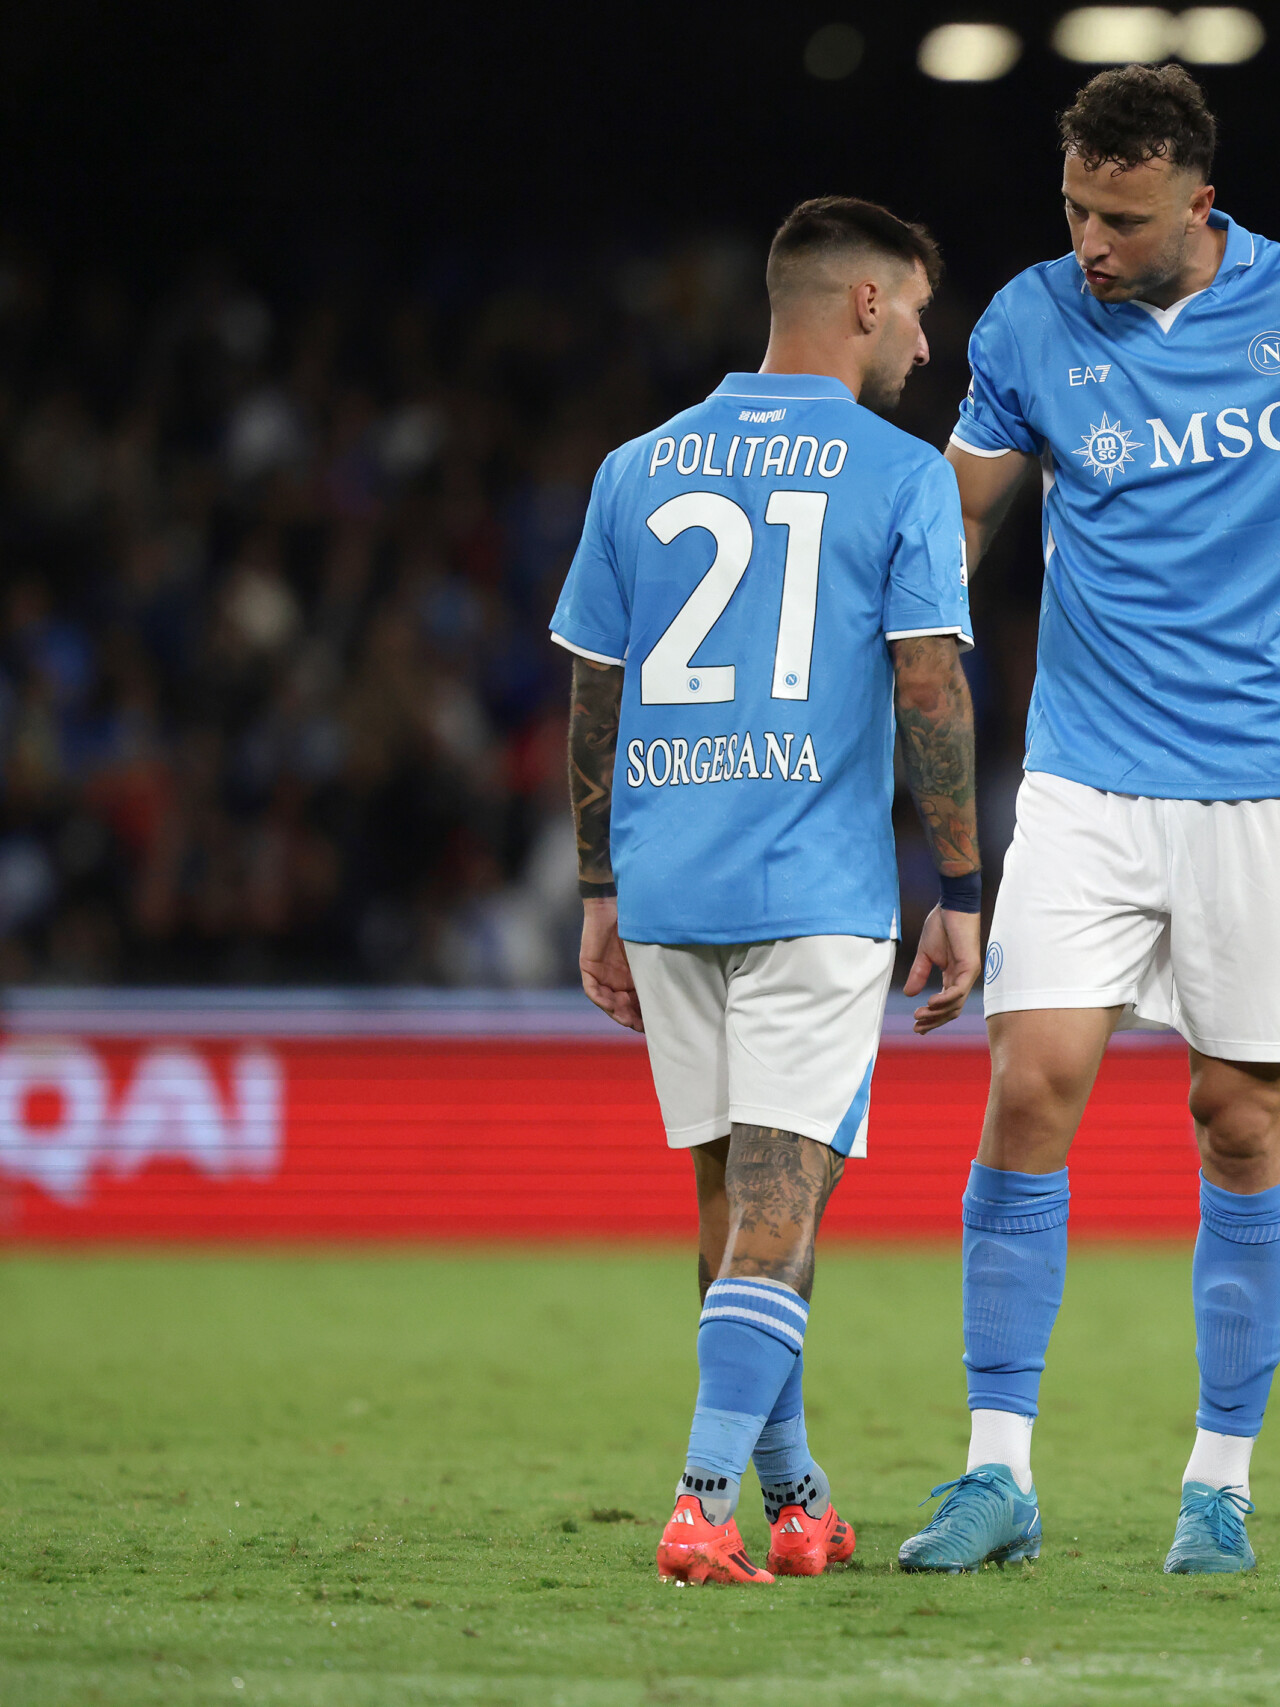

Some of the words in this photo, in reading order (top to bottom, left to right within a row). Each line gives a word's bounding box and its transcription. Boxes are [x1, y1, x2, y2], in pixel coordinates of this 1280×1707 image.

[1068, 363, 1112, 387] EA7
[749, 407, 787, 424] NAPOLI
[648, 432, 849, 478] POLITANO
[640, 490, 829, 705] 21
[626, 731, 822, 788] SORGESANA
